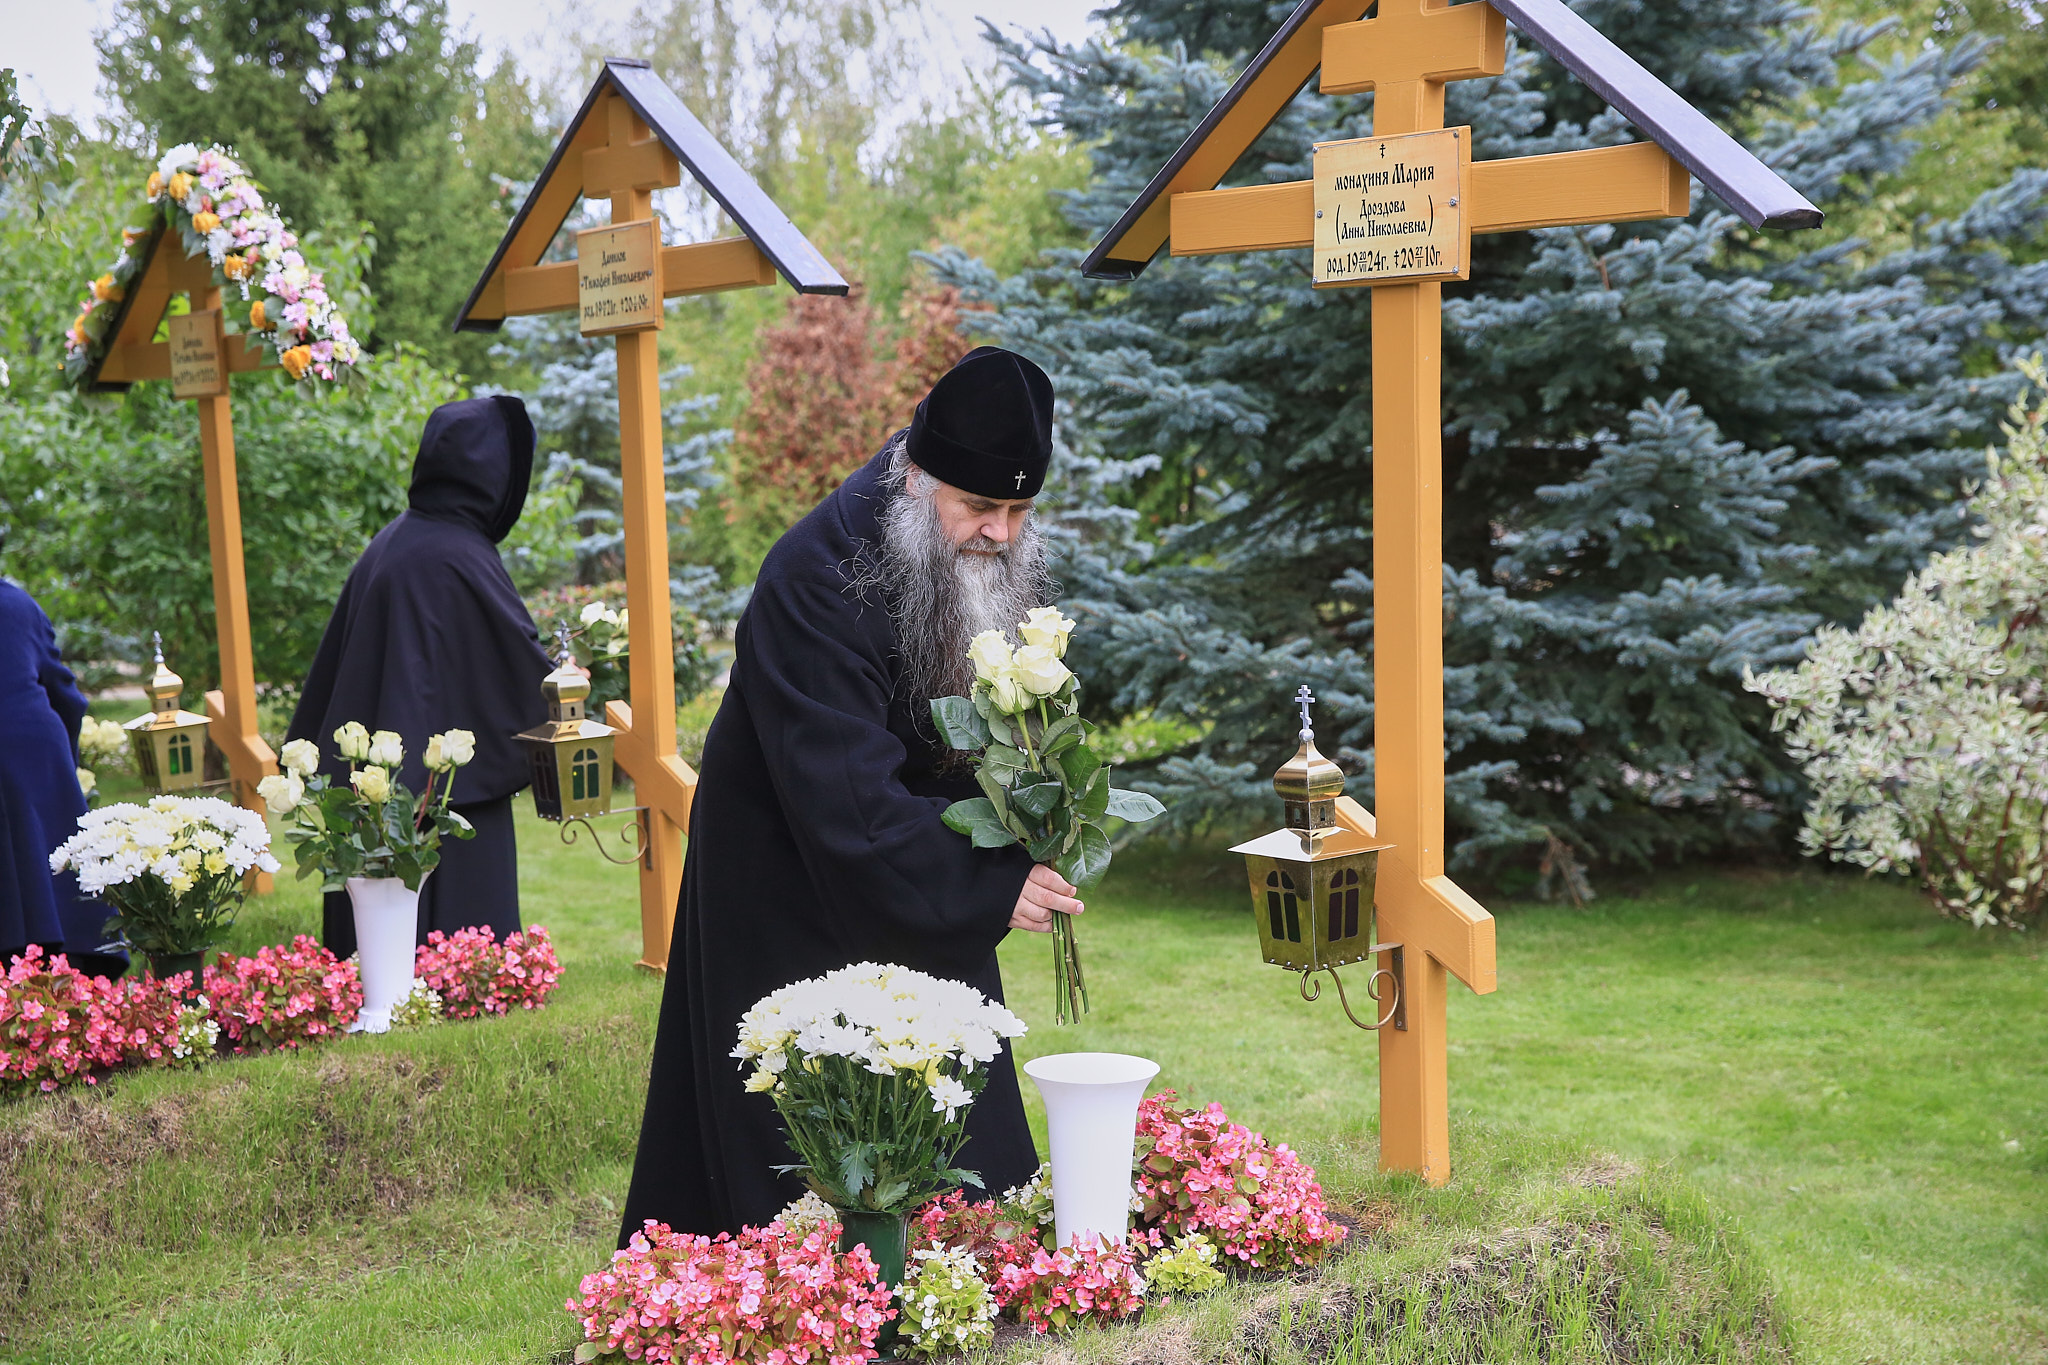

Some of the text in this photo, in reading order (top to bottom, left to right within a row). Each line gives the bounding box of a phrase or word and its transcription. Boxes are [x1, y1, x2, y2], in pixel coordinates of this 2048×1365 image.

[1334, 163, 1434, 194] монахиня Мария
[1359, 199, 1406, 220] Дроздова
